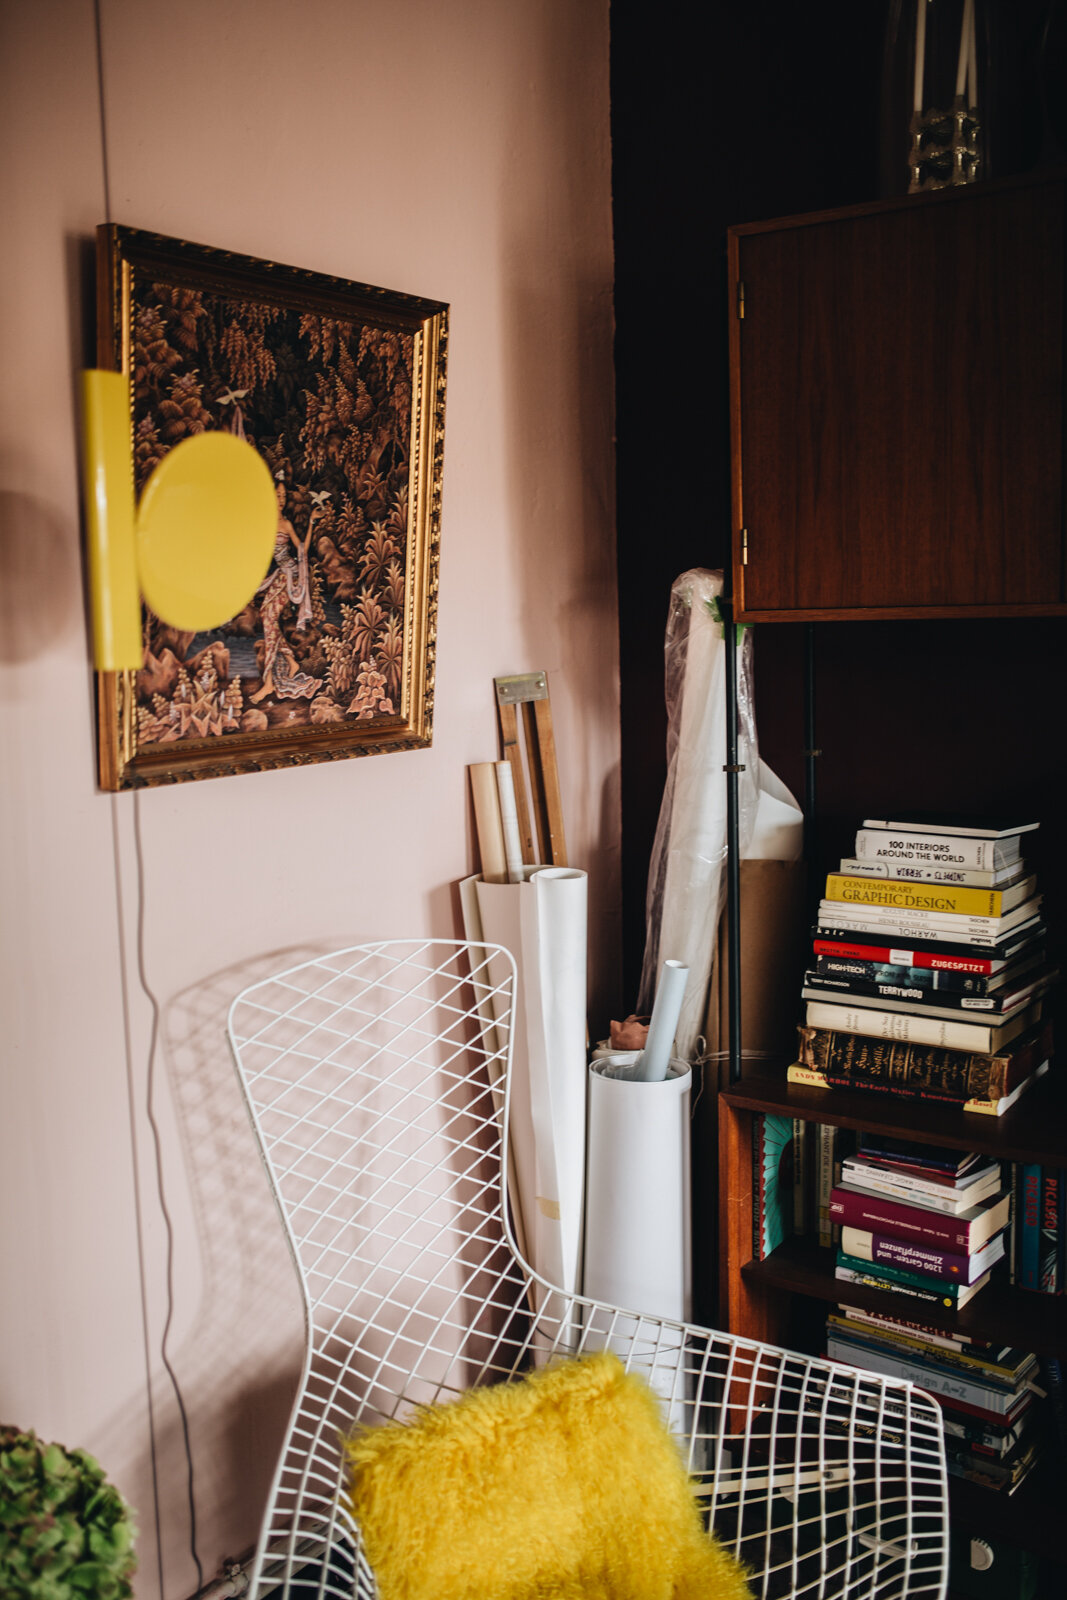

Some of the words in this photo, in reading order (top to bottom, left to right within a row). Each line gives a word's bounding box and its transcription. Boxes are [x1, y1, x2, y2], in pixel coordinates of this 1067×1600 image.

[889, 840, 903, 848] 100
[906, 842, 950, 852] INTERIORS
[876, 850, 914, 859] AROUND
[916, 852, 931, 860] THE
[934, 853, 965, 863] WORLD
[896, 868, 924, 878] SERBIA
[844, 880, 914, 894] CONTEMPORARY
[842, 889, 902, 906] GRAPHIC
[905, 895, 956, 910] DESIGN
[899, 928, 938, 939] WARHOL
[827, 962, 866, 974] HIGH-TECH
[931, 960, 985, 972] ZUGESPITZT
[878, 985, 923, 999] TERRYWOOD
[1025, 1175, 1038, 1226] PICASSO
[1045, 1178, 1057, 1229] PICASSO
[876, 1250, 892, 1260] und
[879, 1242, 943, 1264] Zimmerpflanzen
[893, 1255, 922, 1268] Garten-
[923, 1262, 943, 1273] 1200
[901, 1367, 938, 1388] Design
